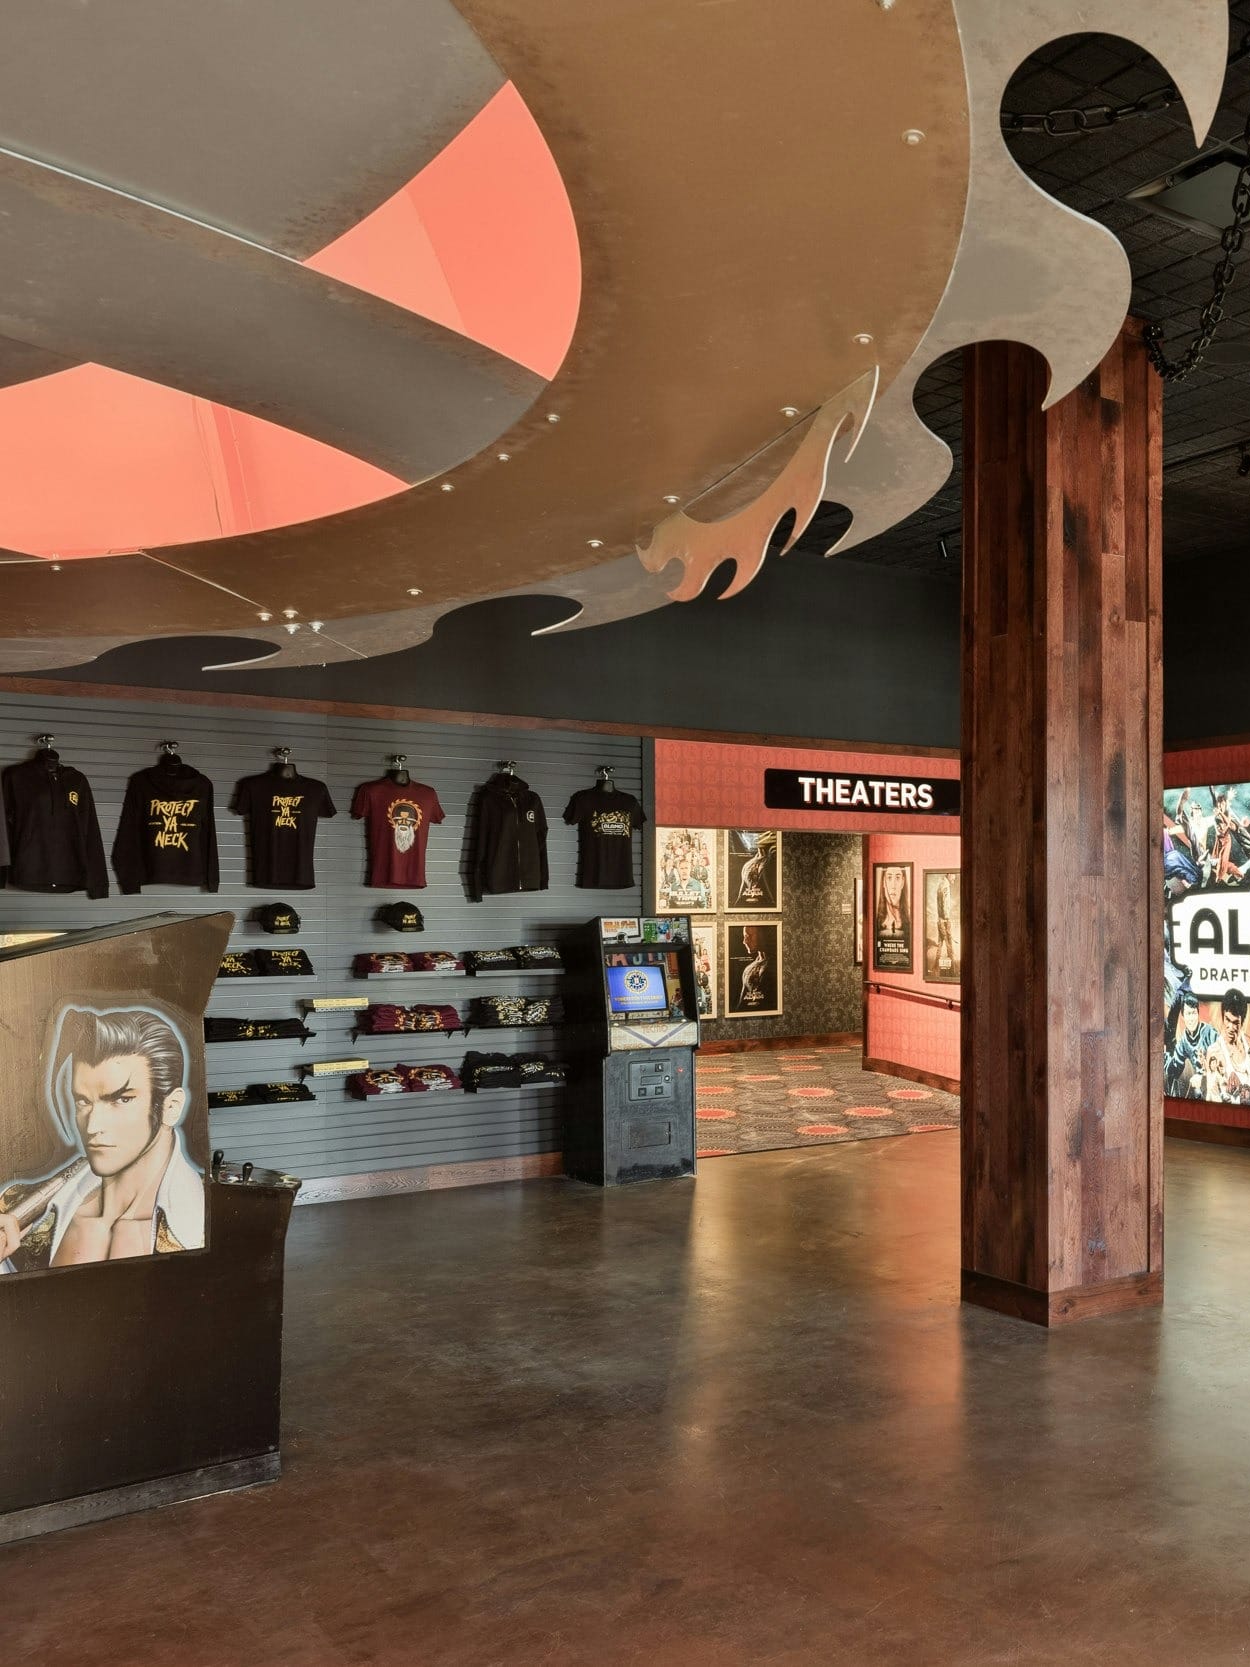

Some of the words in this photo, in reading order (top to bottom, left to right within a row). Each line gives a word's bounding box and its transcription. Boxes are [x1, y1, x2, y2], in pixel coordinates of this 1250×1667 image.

[273, 795, 304, 807] PROTECT
[798, 777, 934, 809] THEATERS
[150, 799, 200, 817] PROTECT
[281, 807, 291, 817] YA
[162, 816, 178, 832] YA
[275, 816, 297, 829] NECK
[155, 831, 189, 851] NECK
